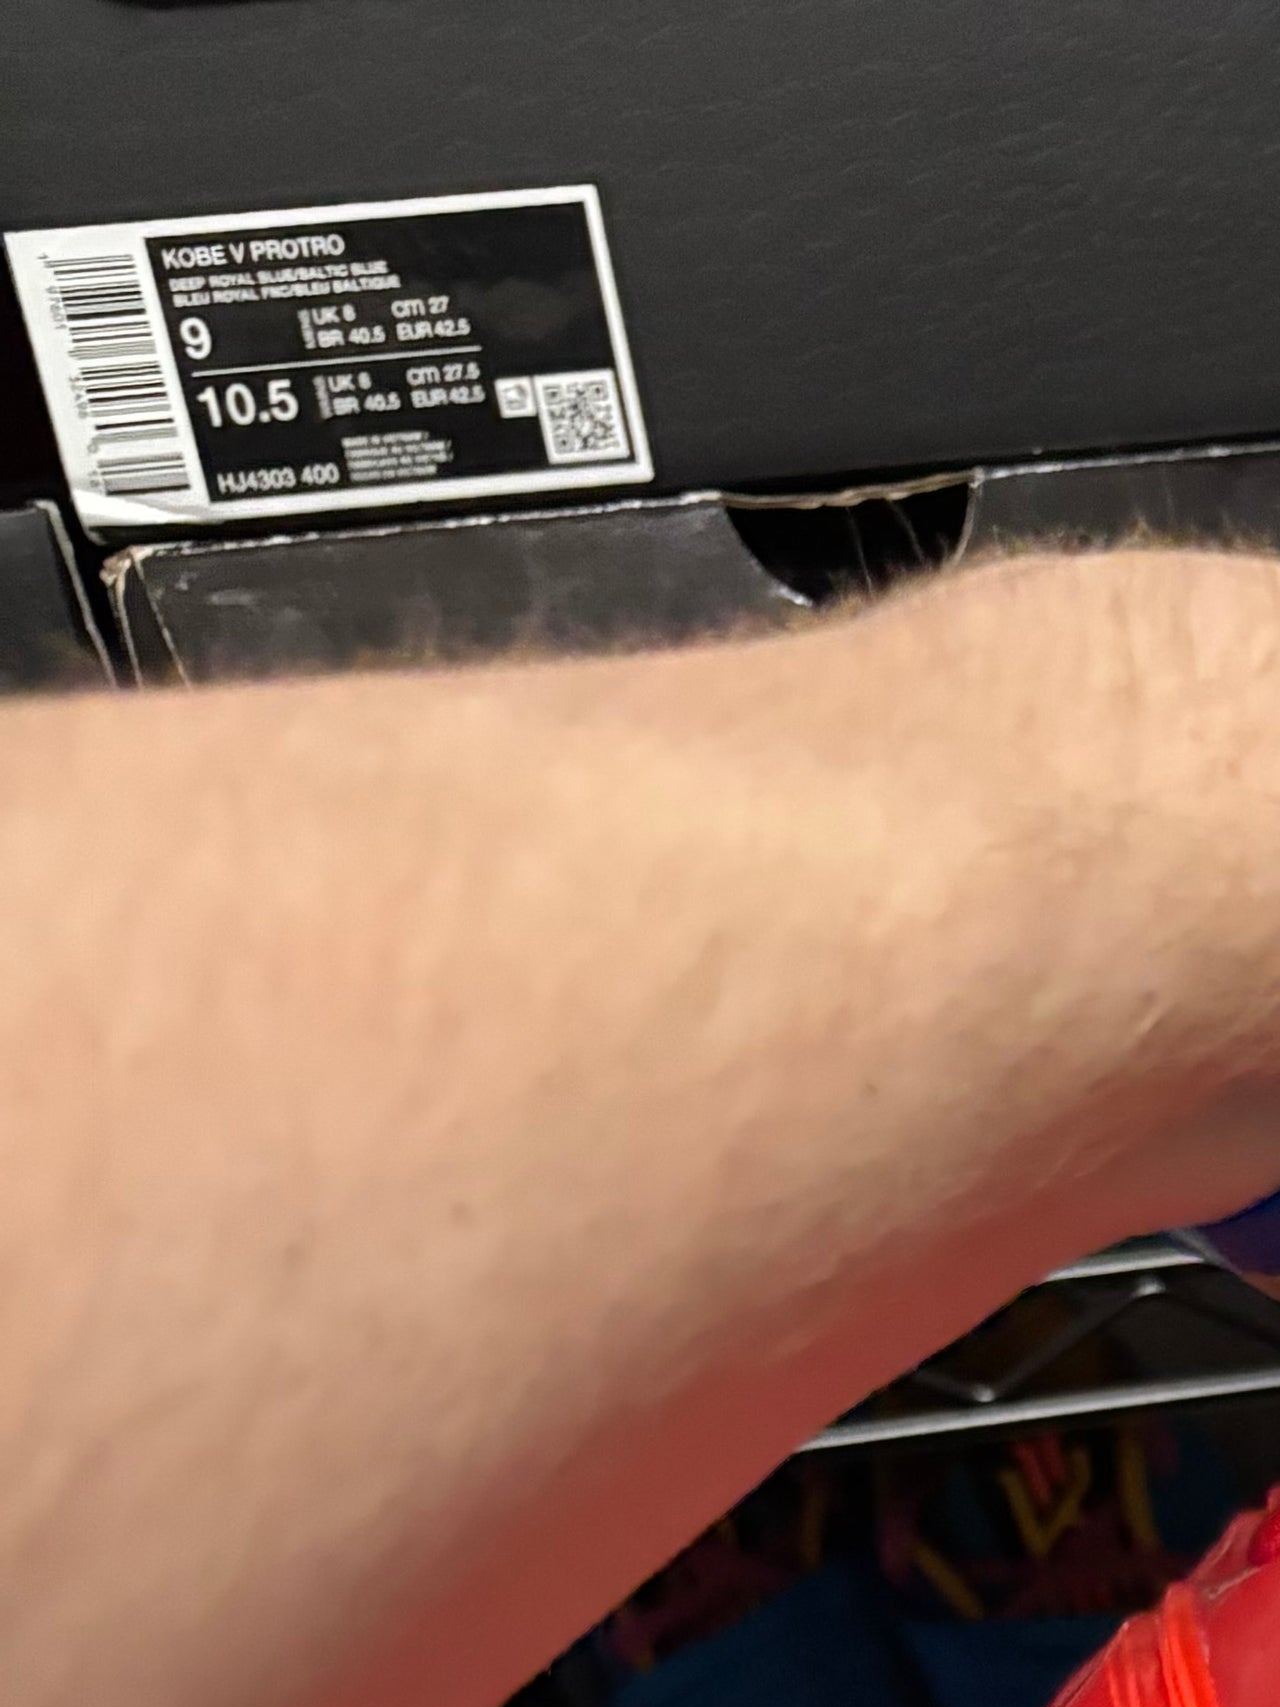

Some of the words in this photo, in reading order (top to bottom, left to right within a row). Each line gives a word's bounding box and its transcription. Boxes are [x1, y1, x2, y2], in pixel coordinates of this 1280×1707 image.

[161, 244, 227, 270] KOBE
[228, 243, 245, 264] V
[250, 234, 345, 262] PROTRO
[312, 305, 340, 326] UK
[396, 320, 434, 341] EUR
[179, 317, 212, 360] 9
[328, 373, 356, 393] UK
[196, 378, 299, 428] 10.5
[217, 466, 296, 495] HJ4303
[301, 462, 340, 485] 400
